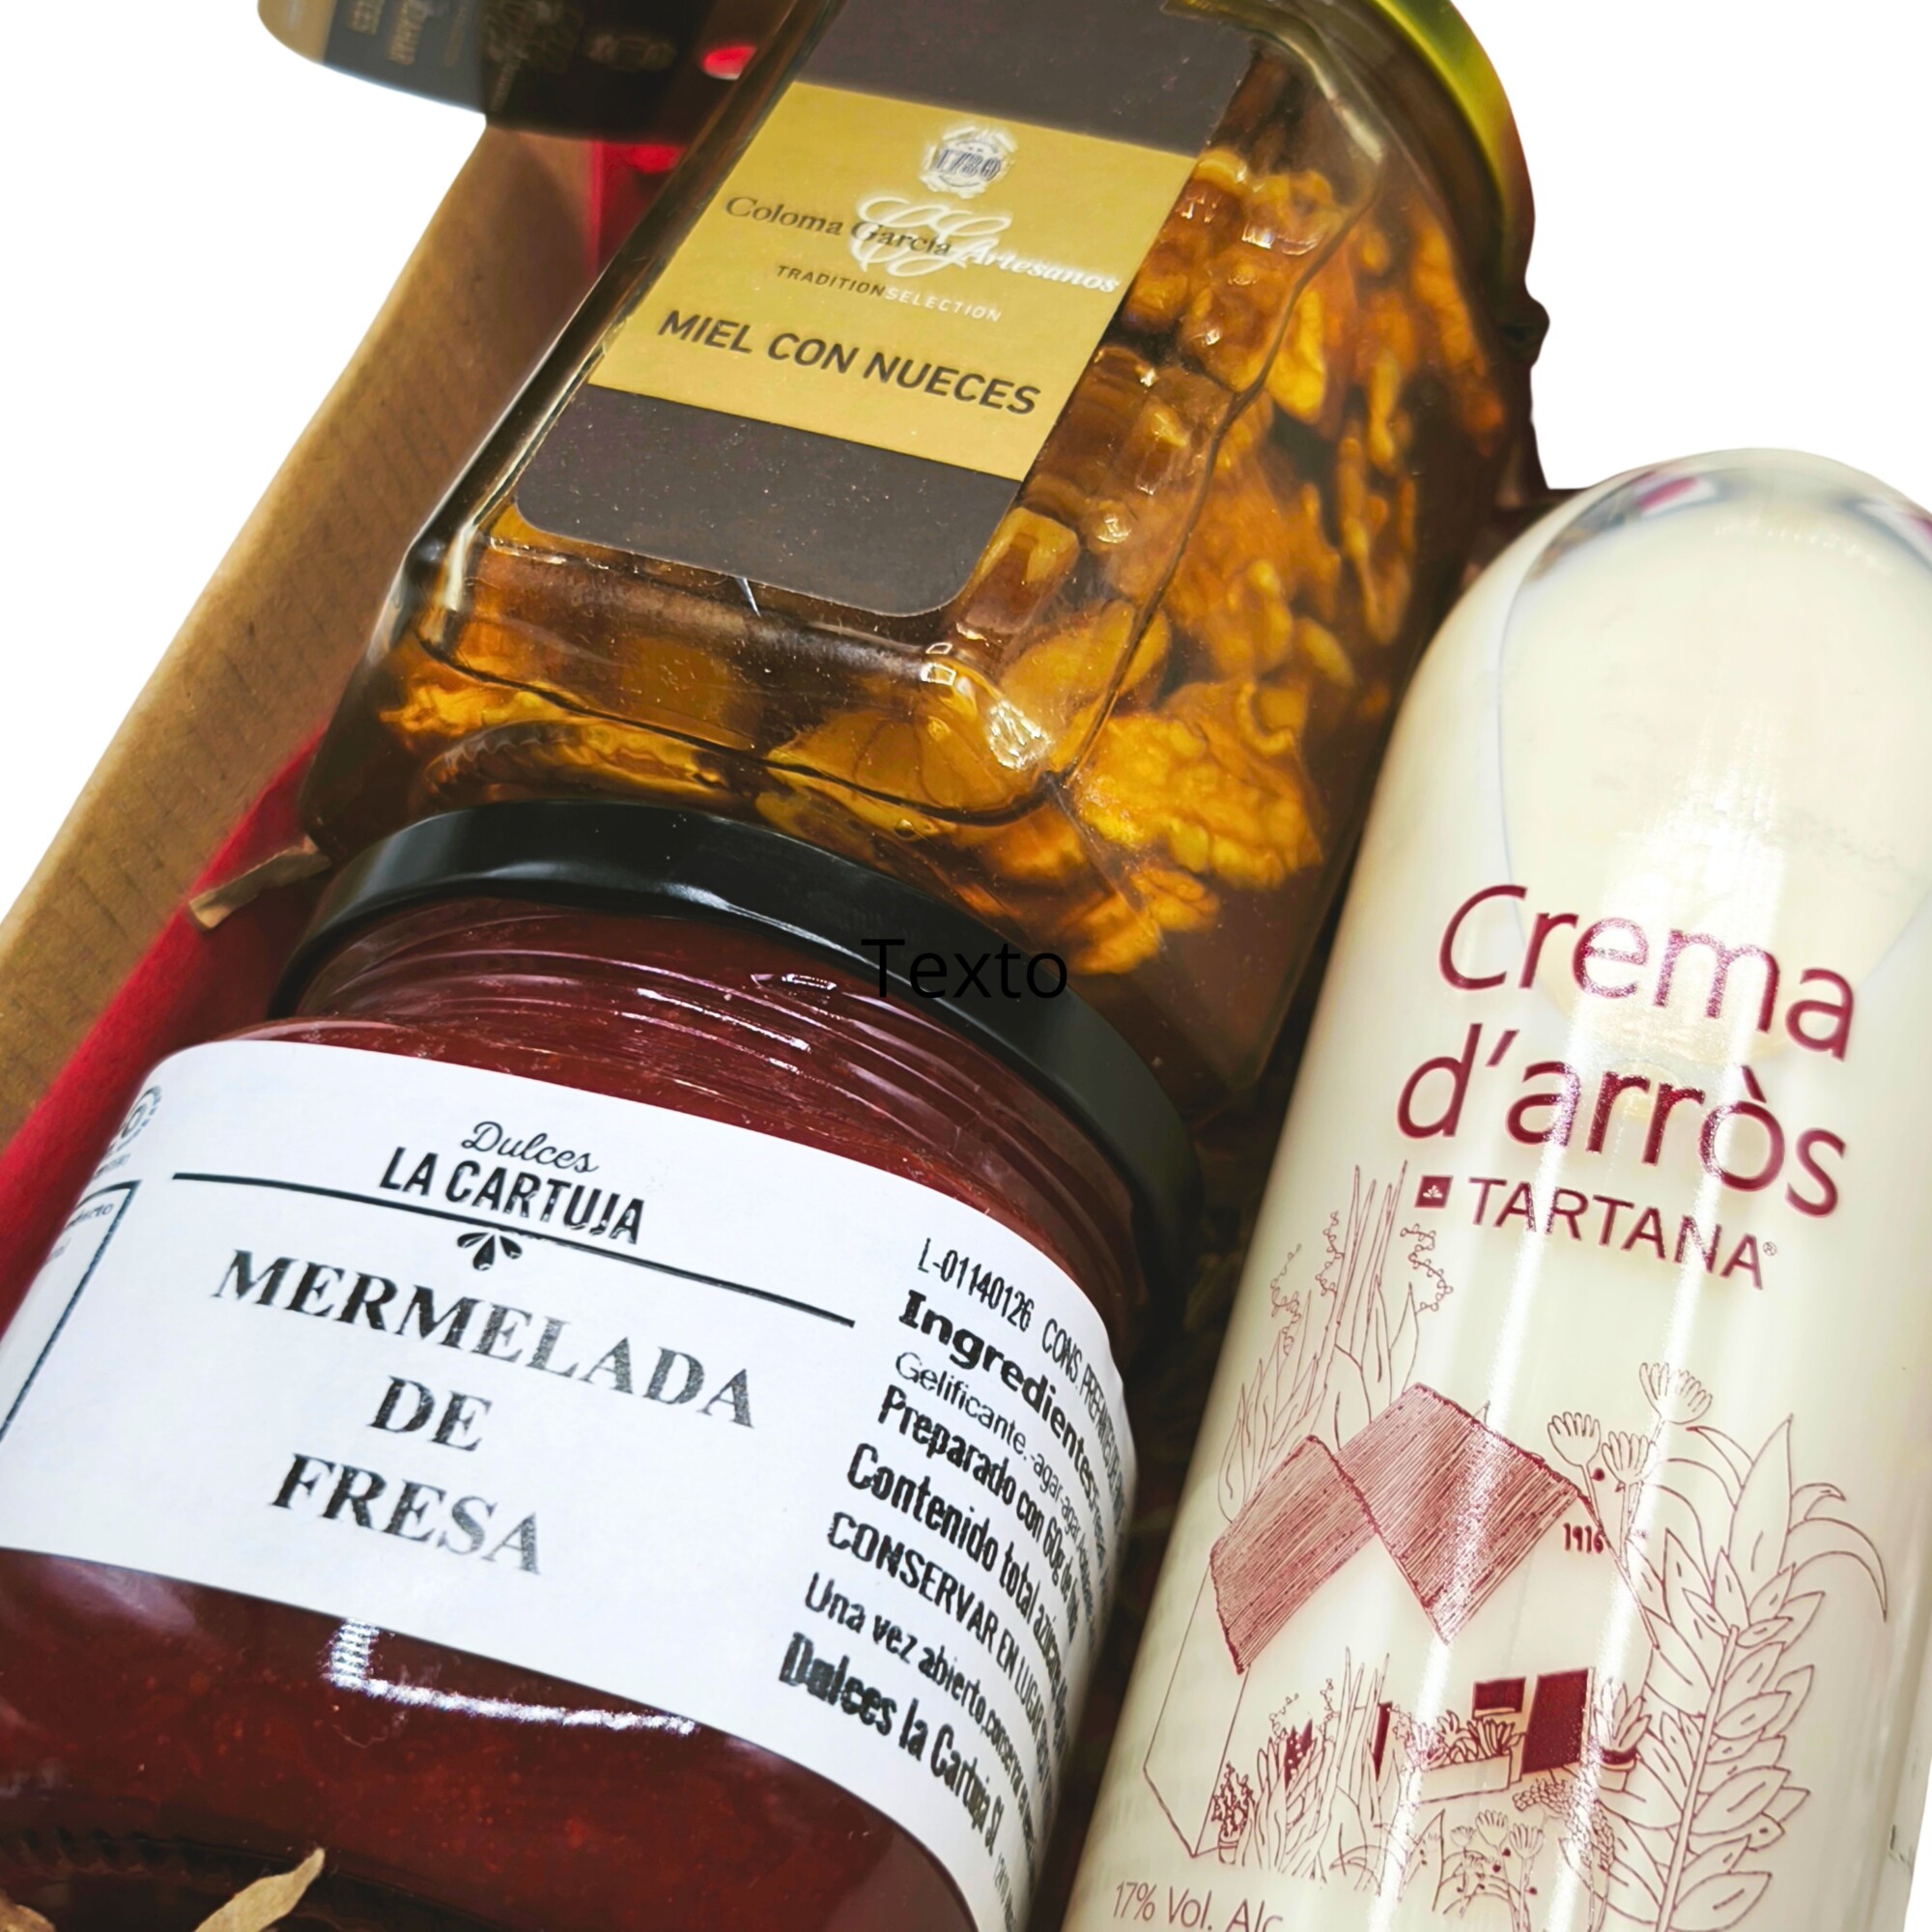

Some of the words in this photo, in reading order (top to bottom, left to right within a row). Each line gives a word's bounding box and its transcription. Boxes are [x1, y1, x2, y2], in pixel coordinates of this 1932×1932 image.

[724, 196, 843, 237] Coloma
[966, 242, 1121, 293] Artesanos
[658, 309, 753, 355] MIEL
[767, 331, 861, 375] CON
[862, 352, 1041, 415] NUECES
[1437, 883, 1856, 1062] Crema
[379, 1146, 440, 1197] LA
[444, 1159, 645, 1246] CARTUJA
[461, 1121, 600, 1174] Dulces
[1467, 1176, 1764, 1292] TARTANA
[210, 1249, 755, 1430] MERMELADA
[367, 1376, 493, 1451] DE
[877, 1384, 1017, 1507] Preparado
[1015, 1490, 1045, 1544] con
[270, 1453, 542, 1575] FRESA
[847, 1442, 999, 1573] Contenido
[999, 1540, 1041, 1625] total
[1563, 1521, 1605, 1554] 1916
[804, 1572, 867, 1634] Una
[872, 1613, 919, 1664] vez
[827, 1511, 1000, 1654] CONSERVAR
[996, 1627, 1020, 1682] EN
[1014, 1655, 1045, 1745] LUGAR
[779, 1631, 897, 1737] Dulces
[898, 1697, 928, 1762] la
[1112, 1880, 1157, 1922] 17%
[1168, 1886, 1213, 1931] Vol.
